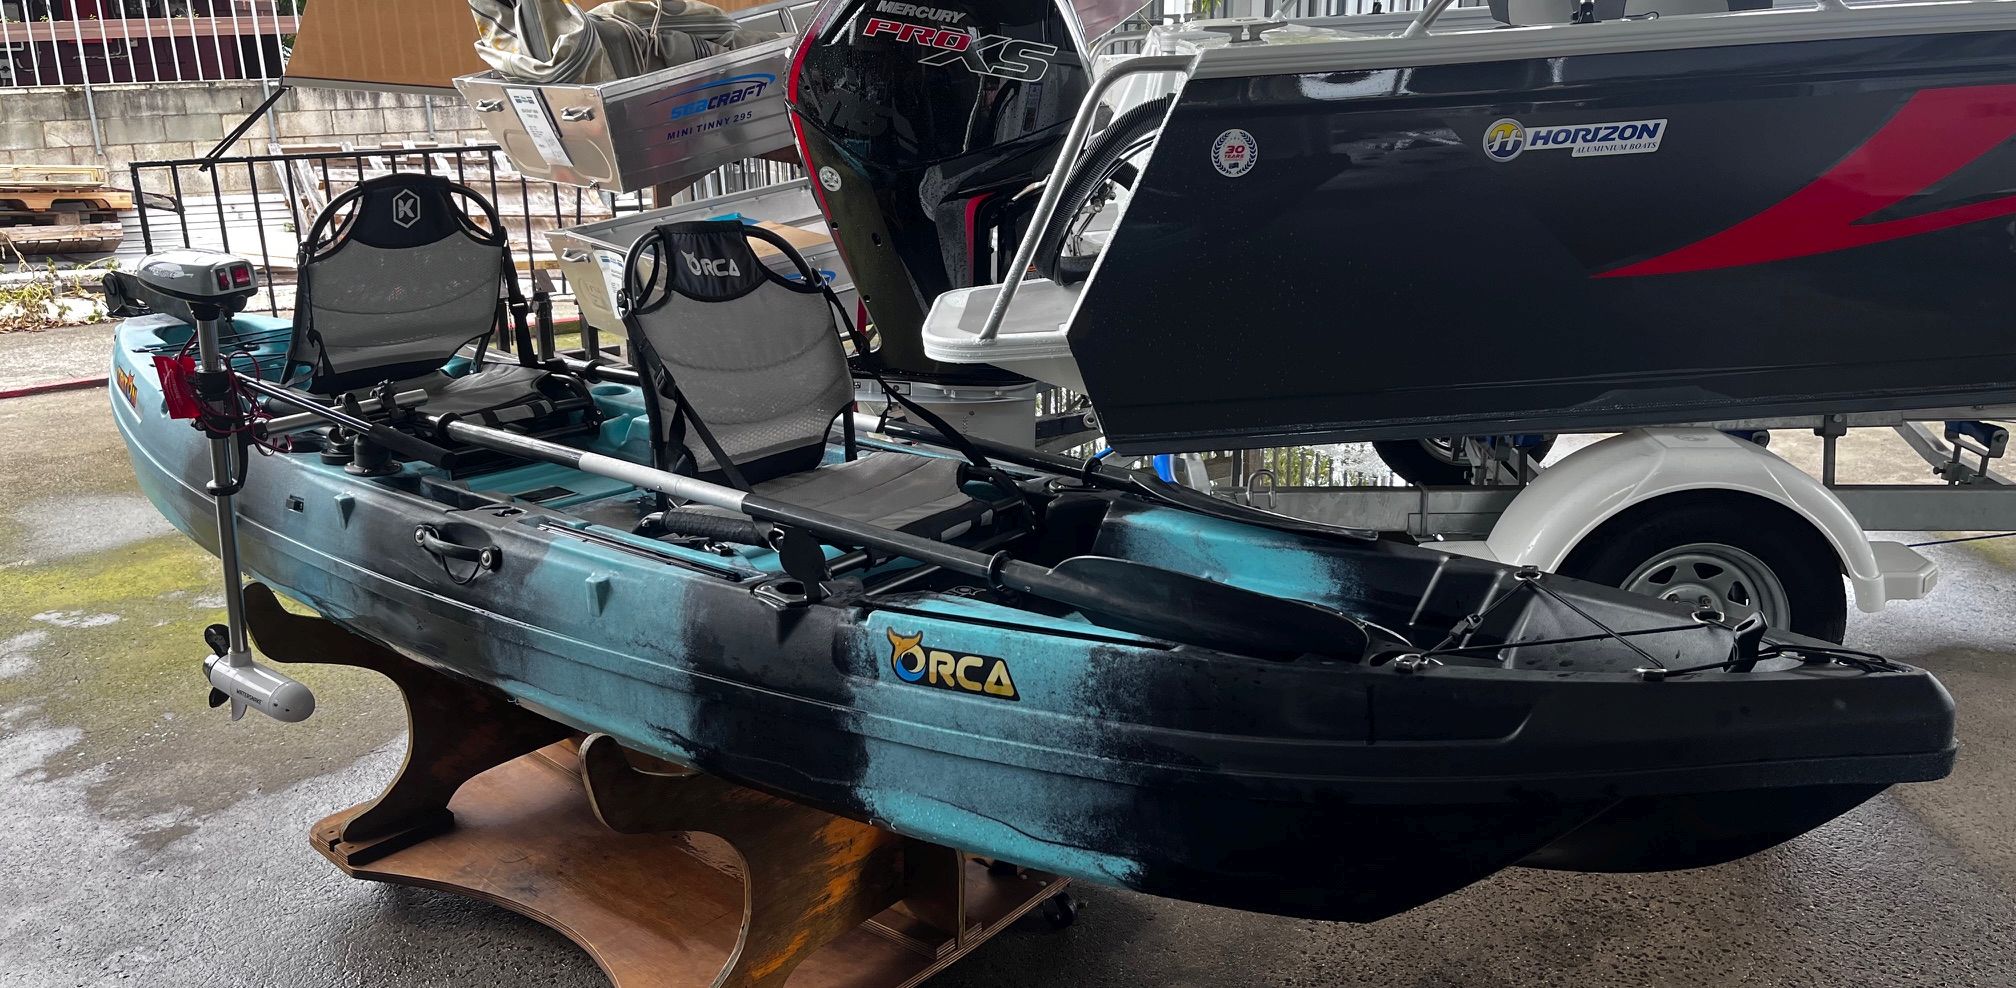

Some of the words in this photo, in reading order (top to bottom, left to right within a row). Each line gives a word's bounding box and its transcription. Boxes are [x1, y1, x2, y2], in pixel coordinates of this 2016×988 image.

[876, 0, 967, 24] MERCURY
[863, 17, 973, 52] PRO
[667, 127, 693, 140] MINI
[697, 117, 730, 133] TINNY
[733, 110, 752, 123] 295
[1530, 122, 1661, 147] HORIZON
[1225, 145, 1245, 154] 30
[1575, 143, 1628, 154] ALUMINIUM
[1629, 141, 1658, 150] BOATS
[680, 249, 741, 277] ORCA
[887, 626, 1015, 697] ORCA
